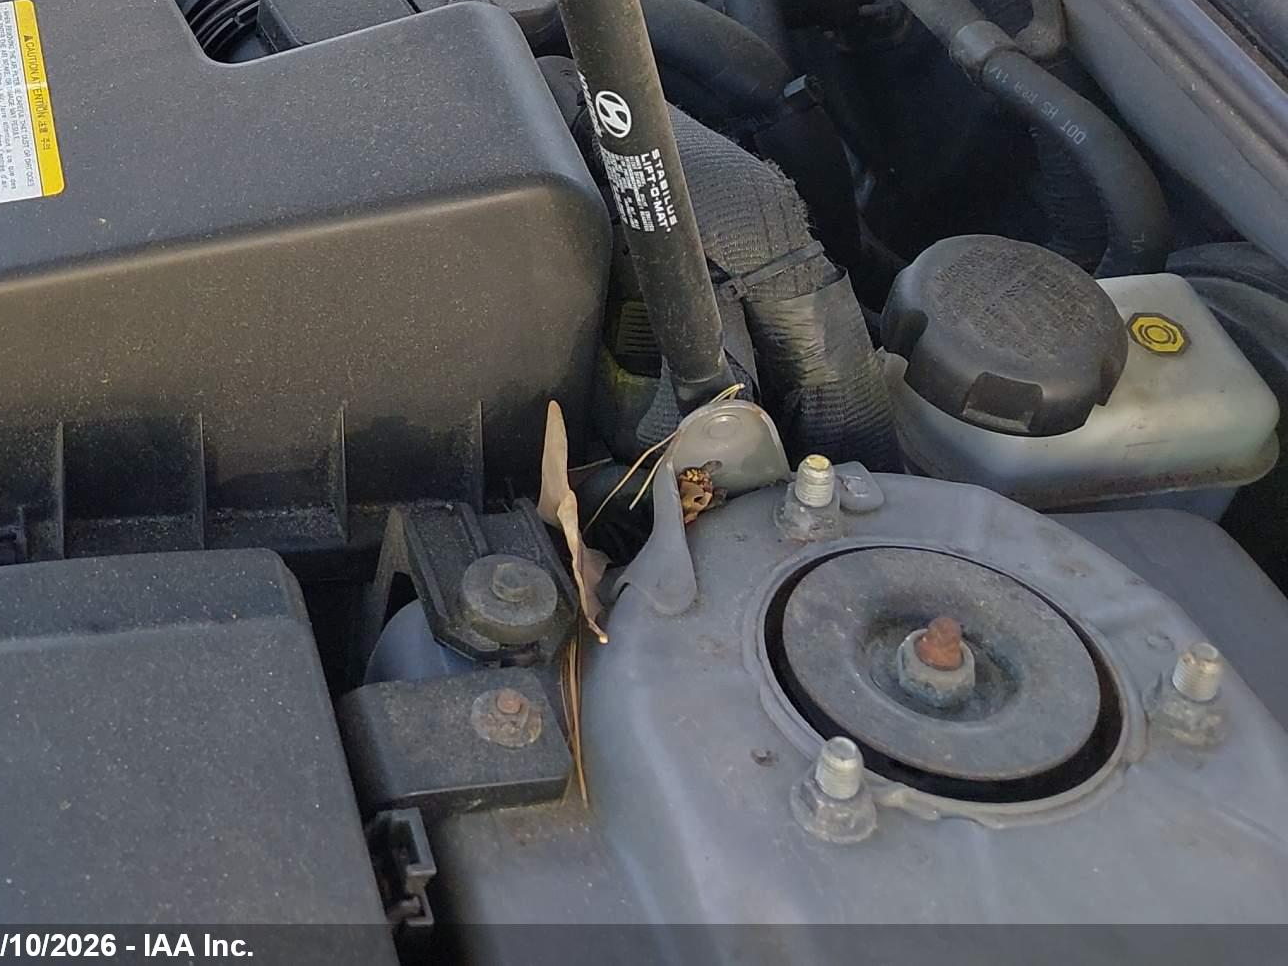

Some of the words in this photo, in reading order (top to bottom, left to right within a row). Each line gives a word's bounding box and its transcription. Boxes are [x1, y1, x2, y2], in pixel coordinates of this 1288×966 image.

[25, 41, 39, 74] CAUTION
[30, 75, 46, 118] ATENTION
[1061, 120, 1087, 145] DOT
[651, 148, 678, 226] STABILUS
